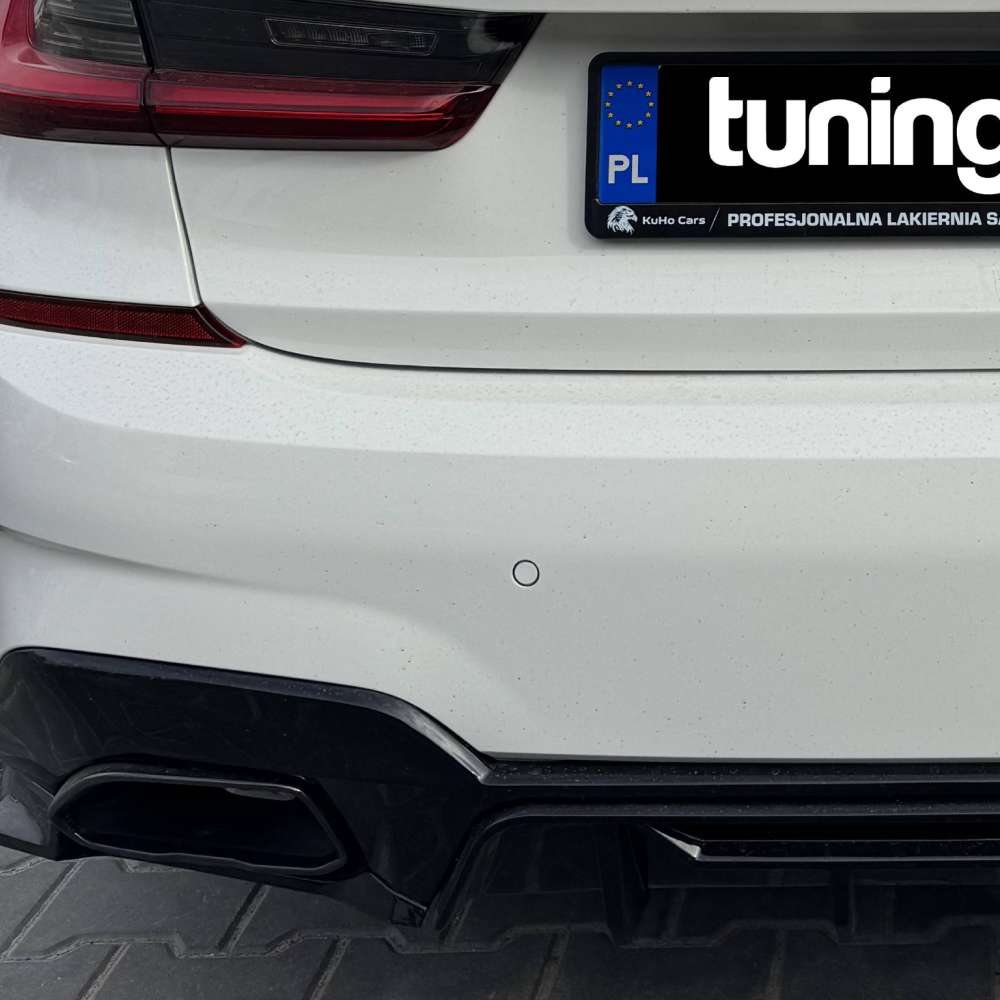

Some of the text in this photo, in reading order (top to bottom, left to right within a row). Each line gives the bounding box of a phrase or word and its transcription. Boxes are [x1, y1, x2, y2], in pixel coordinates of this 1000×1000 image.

[607, 154, 649, 184] PL
[642, 215, 674, 225] KuHo
[677, 215, 706, 225] Cars
[727, 212, 883, 227] PROFESJONALNA
[887, 211, 983, 226] LAKIERNIA
